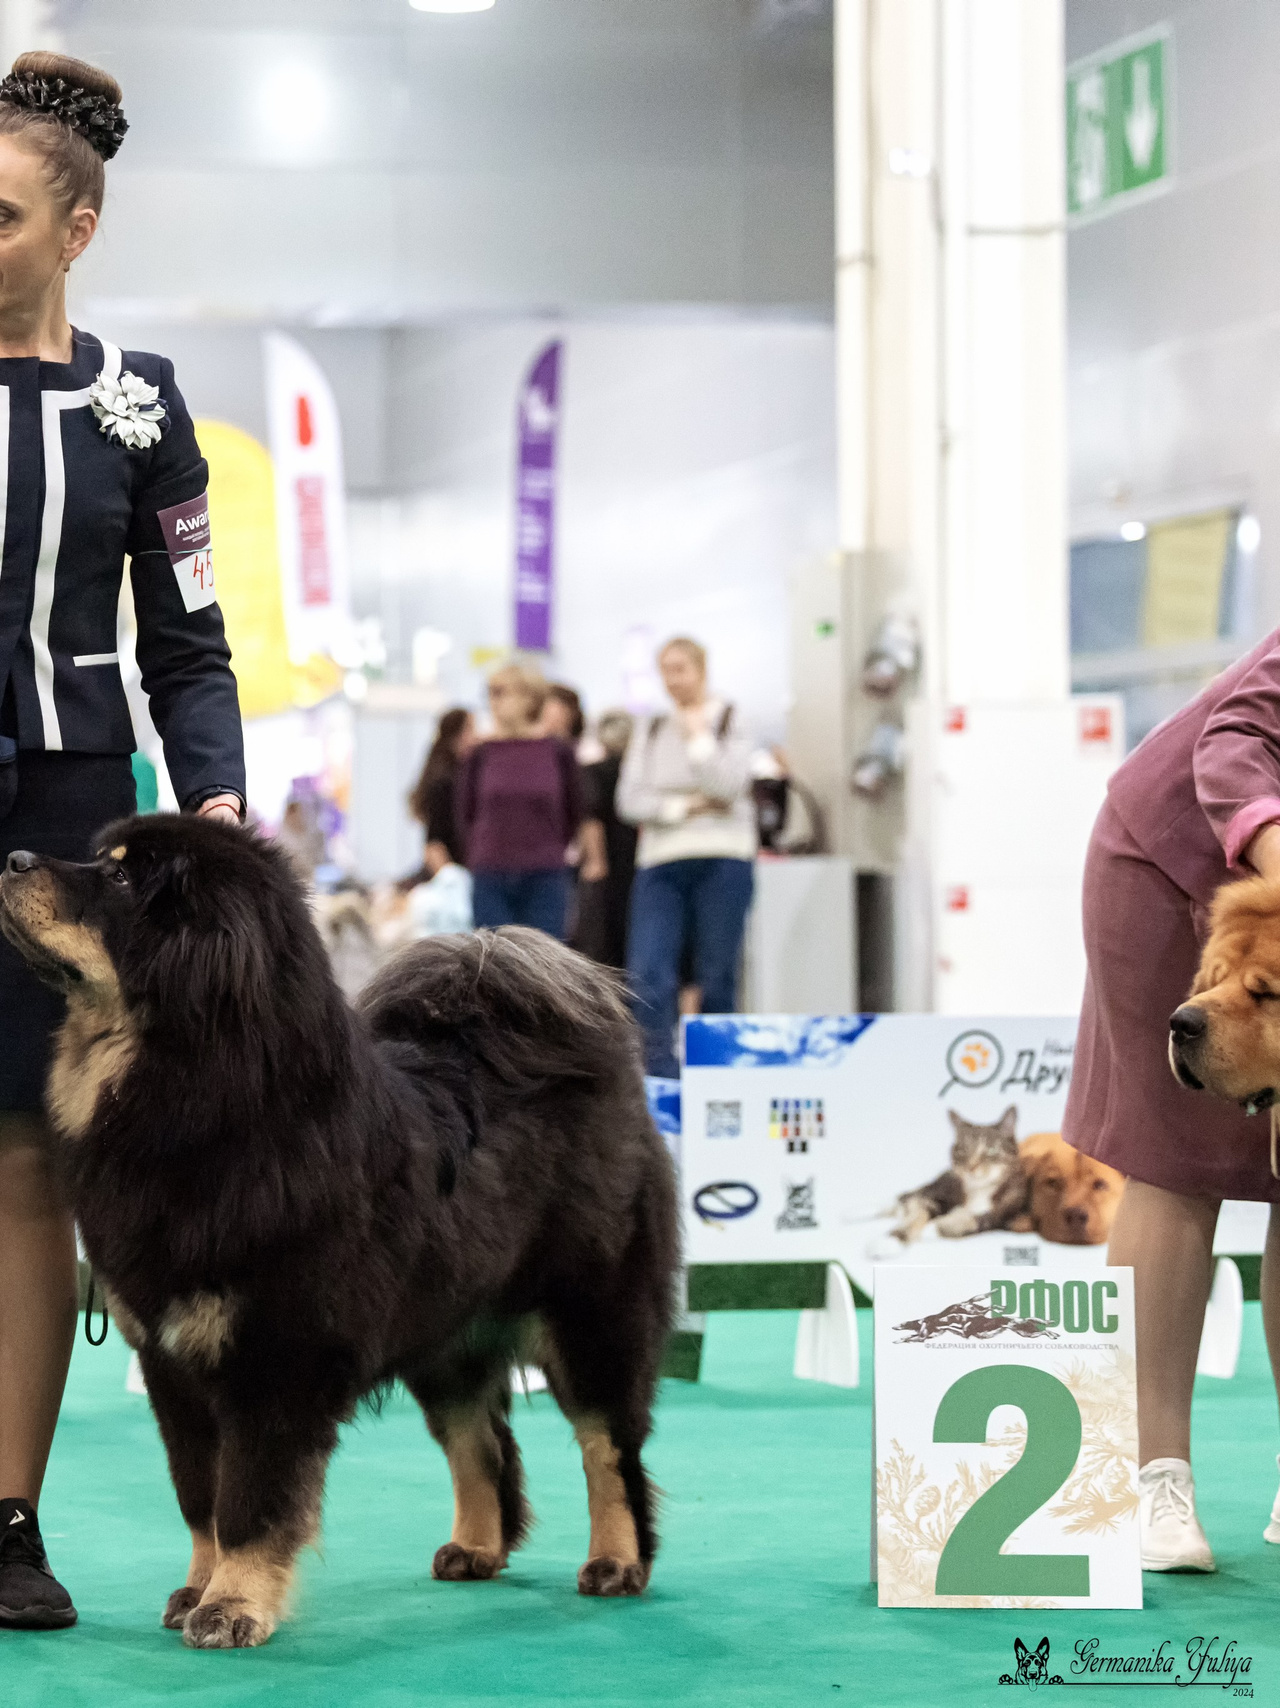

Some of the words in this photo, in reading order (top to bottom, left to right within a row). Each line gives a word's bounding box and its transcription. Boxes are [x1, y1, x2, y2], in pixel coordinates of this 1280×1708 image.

[175, 509, 210, 536] Awar
[1000, 1049, 1072, 1094] Дру
[990, 1279, 1119, 1334] РФОС
[924, 1342, 977, 1350] ФЕДЕРАЦИЯ
[933, 1364, 1090, 1597] 2
